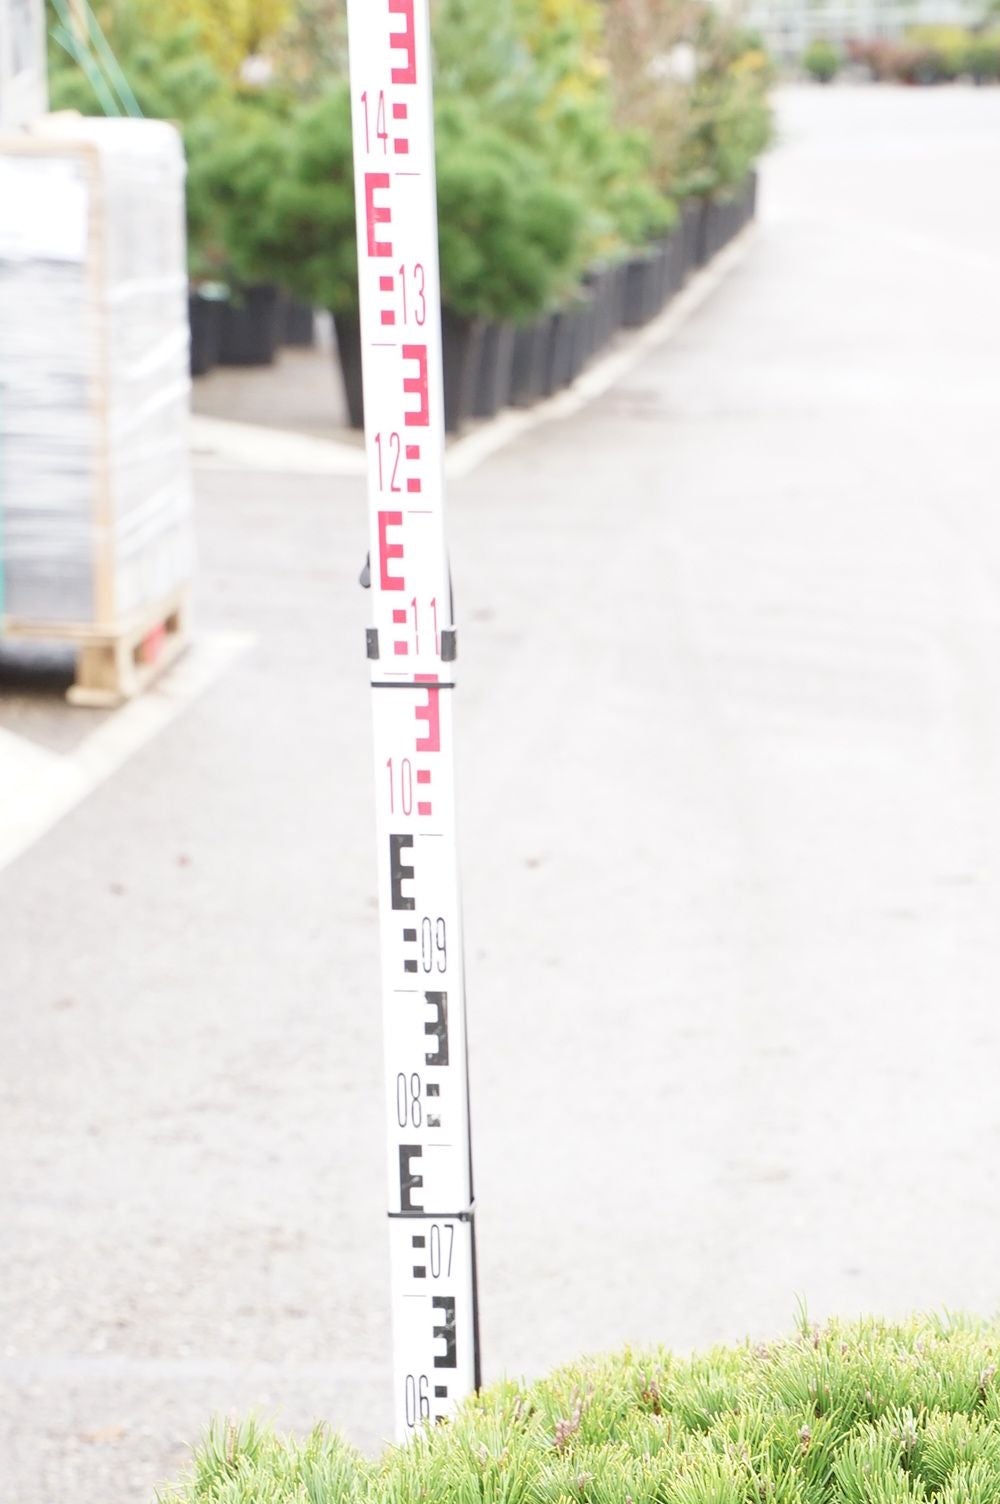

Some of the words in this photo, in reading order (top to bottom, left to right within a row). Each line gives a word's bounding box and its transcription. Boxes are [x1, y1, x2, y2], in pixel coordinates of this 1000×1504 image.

[361, 90, 388, 155] 14
[399, 263, 426, 326] 13
[375, 432, 401, 492] 12
[411, 596, 439, 655] 11
[386, 757, 412, 816] 10
[421, 916, 447, 973] 09
[397, 1072, 422, 1128] 08
[430, 1224, 454, 1279] 07
[405, 1374, 430, 1428] 06
